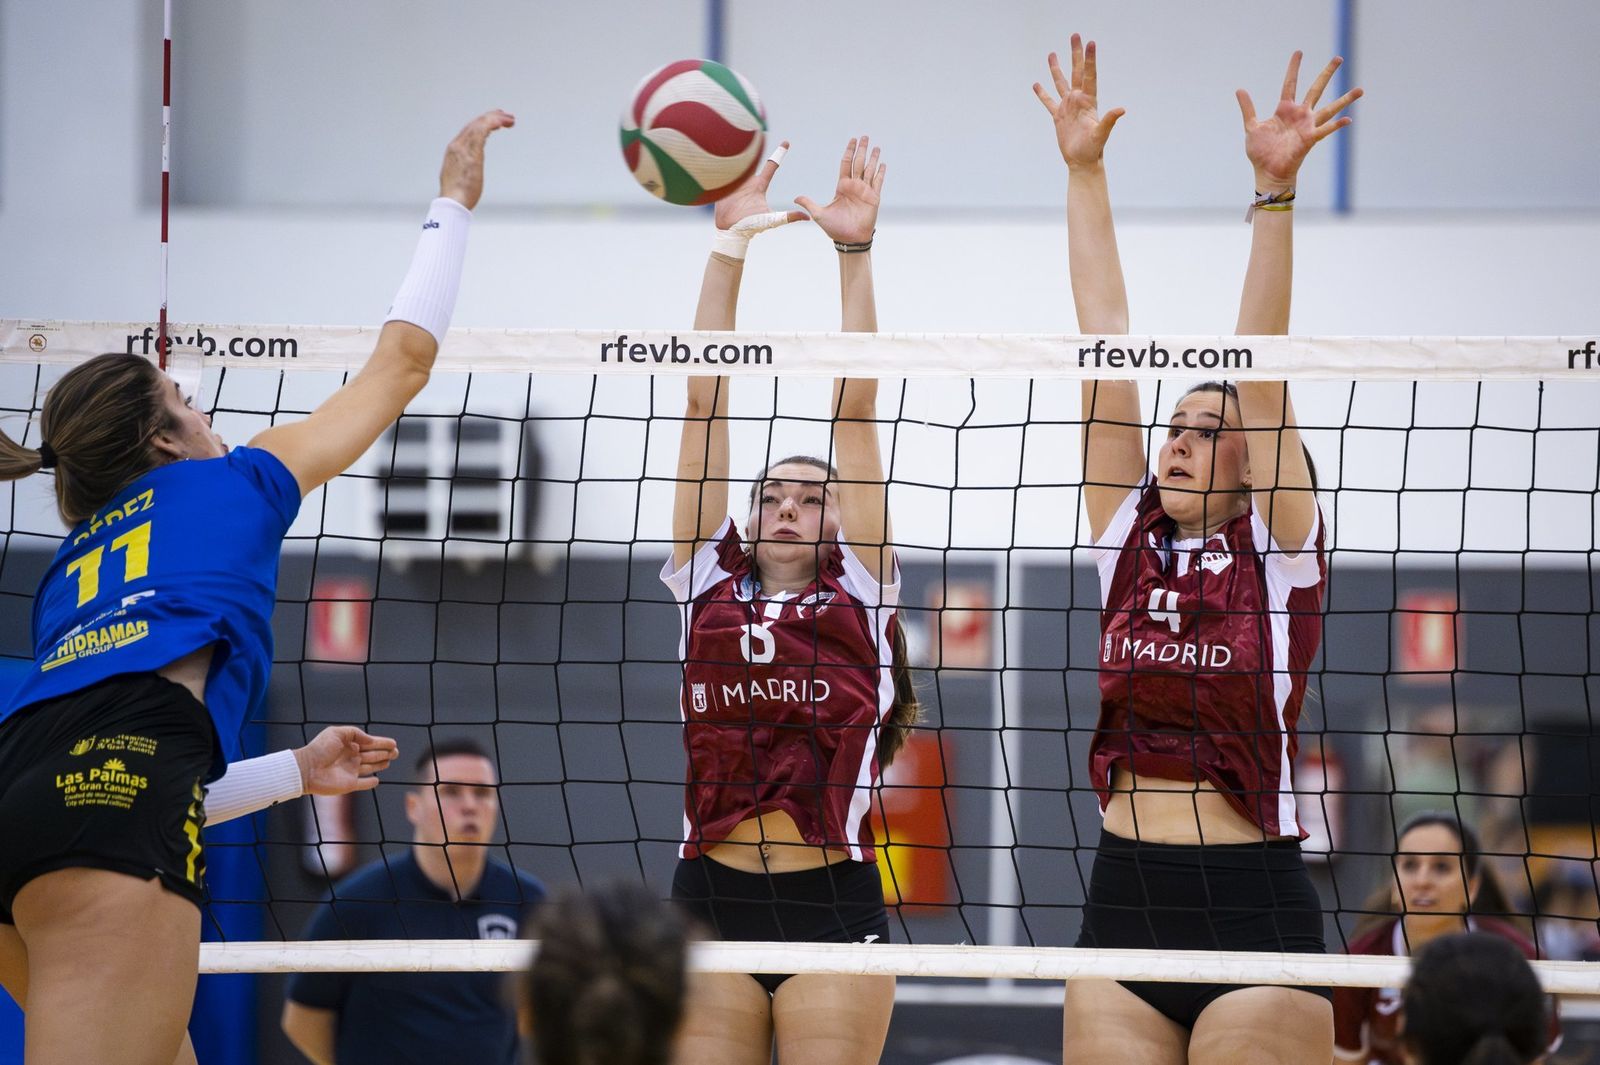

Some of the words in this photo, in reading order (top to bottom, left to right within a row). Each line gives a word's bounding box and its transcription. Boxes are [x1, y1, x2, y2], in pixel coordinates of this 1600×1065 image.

[601, 335, 772, 364] rfevb.com
[1078, 340, 1252, 368] rfevb.com
[1567, 341, 1600, 369] rf
[66, 520, 152, 608] 11
[1148, 588, 1181, 633] 4
[78, 643, 113, 658] GROUP
[1121, 637, 1232, 668] MADRID
[722, 678, 831, 707] MADRID
[56, 772, 84, 788] Las
[89, 767, 148, 790] Palmas
[65, 784, 77, 794] de
[79, 782, 102, 791] Gran
[104, 782, 137, 796] Canaria
